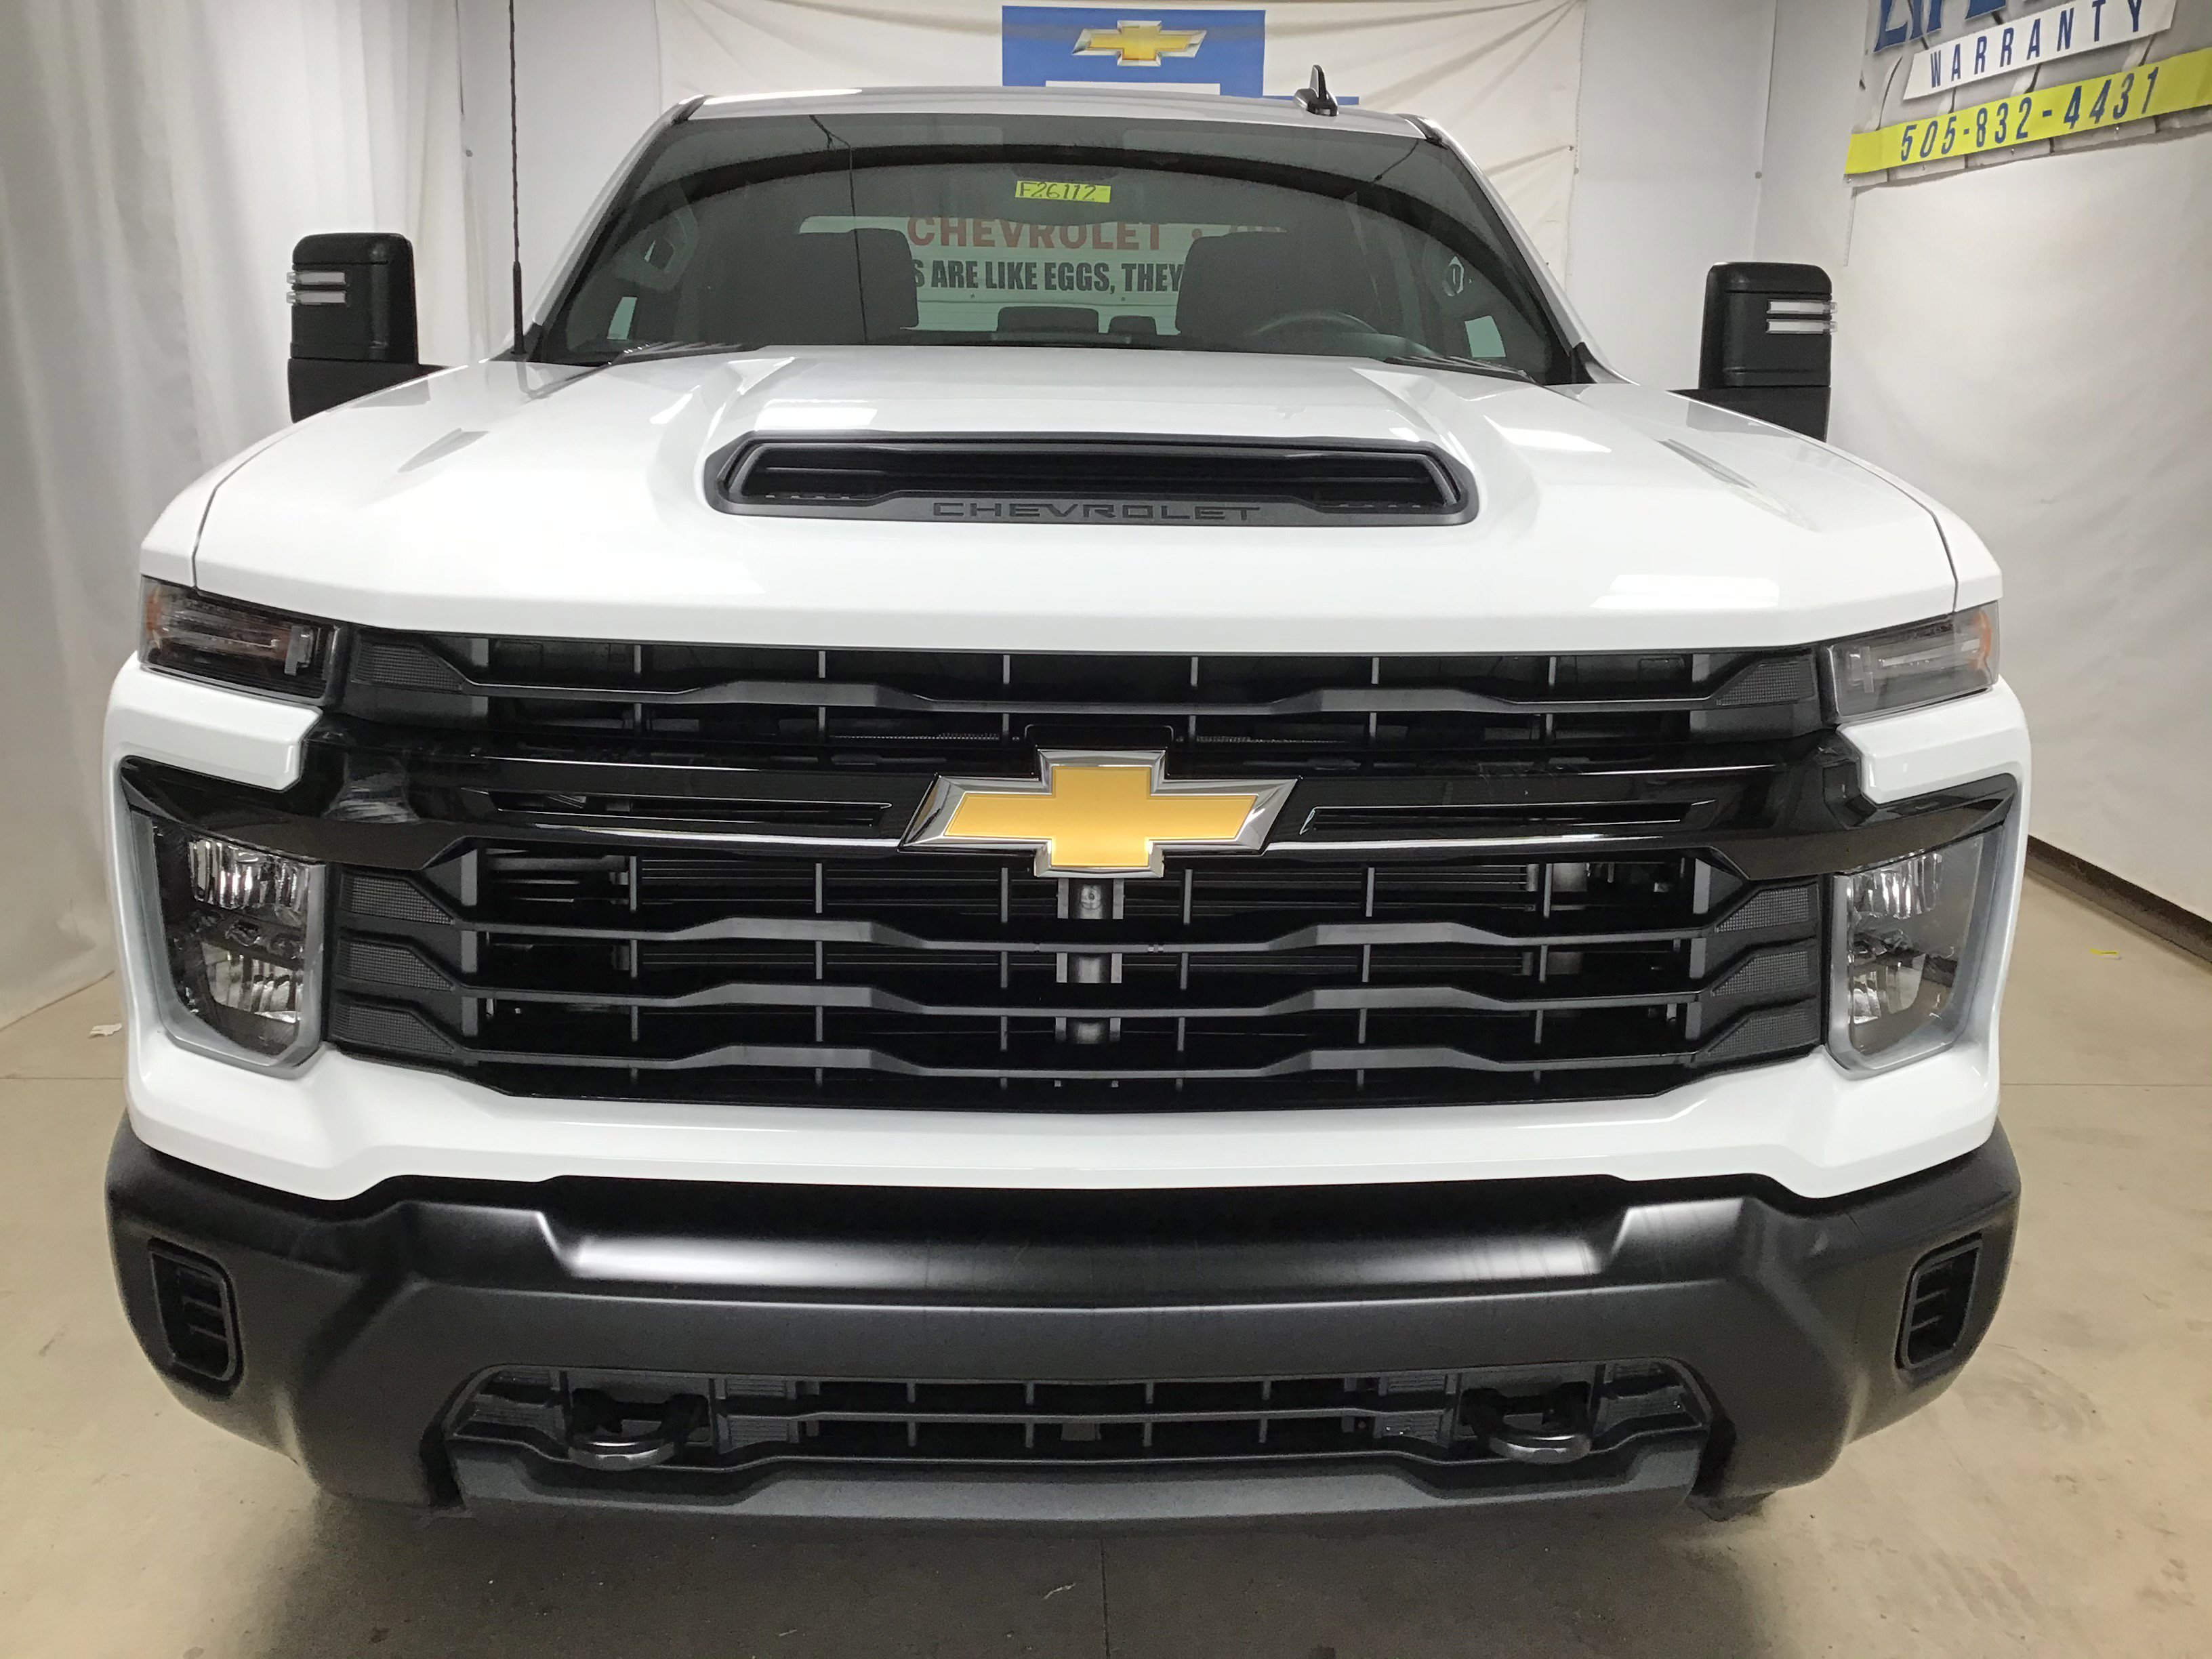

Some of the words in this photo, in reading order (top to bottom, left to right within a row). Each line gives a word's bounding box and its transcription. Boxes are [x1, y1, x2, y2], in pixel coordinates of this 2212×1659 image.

[1929, 0, 2142, 88] WARRANTY
[1900, 66, 2158, 161] 505-832-4431
[1019, 181, 1097, 201] F26112
[930, 260, 979, 289] ARE
[985, 261, 1038, 290] LIKE
[1044, 262, 1115, 295] EGGS,
[933, 501, 1261, 521] CHEVROLET
